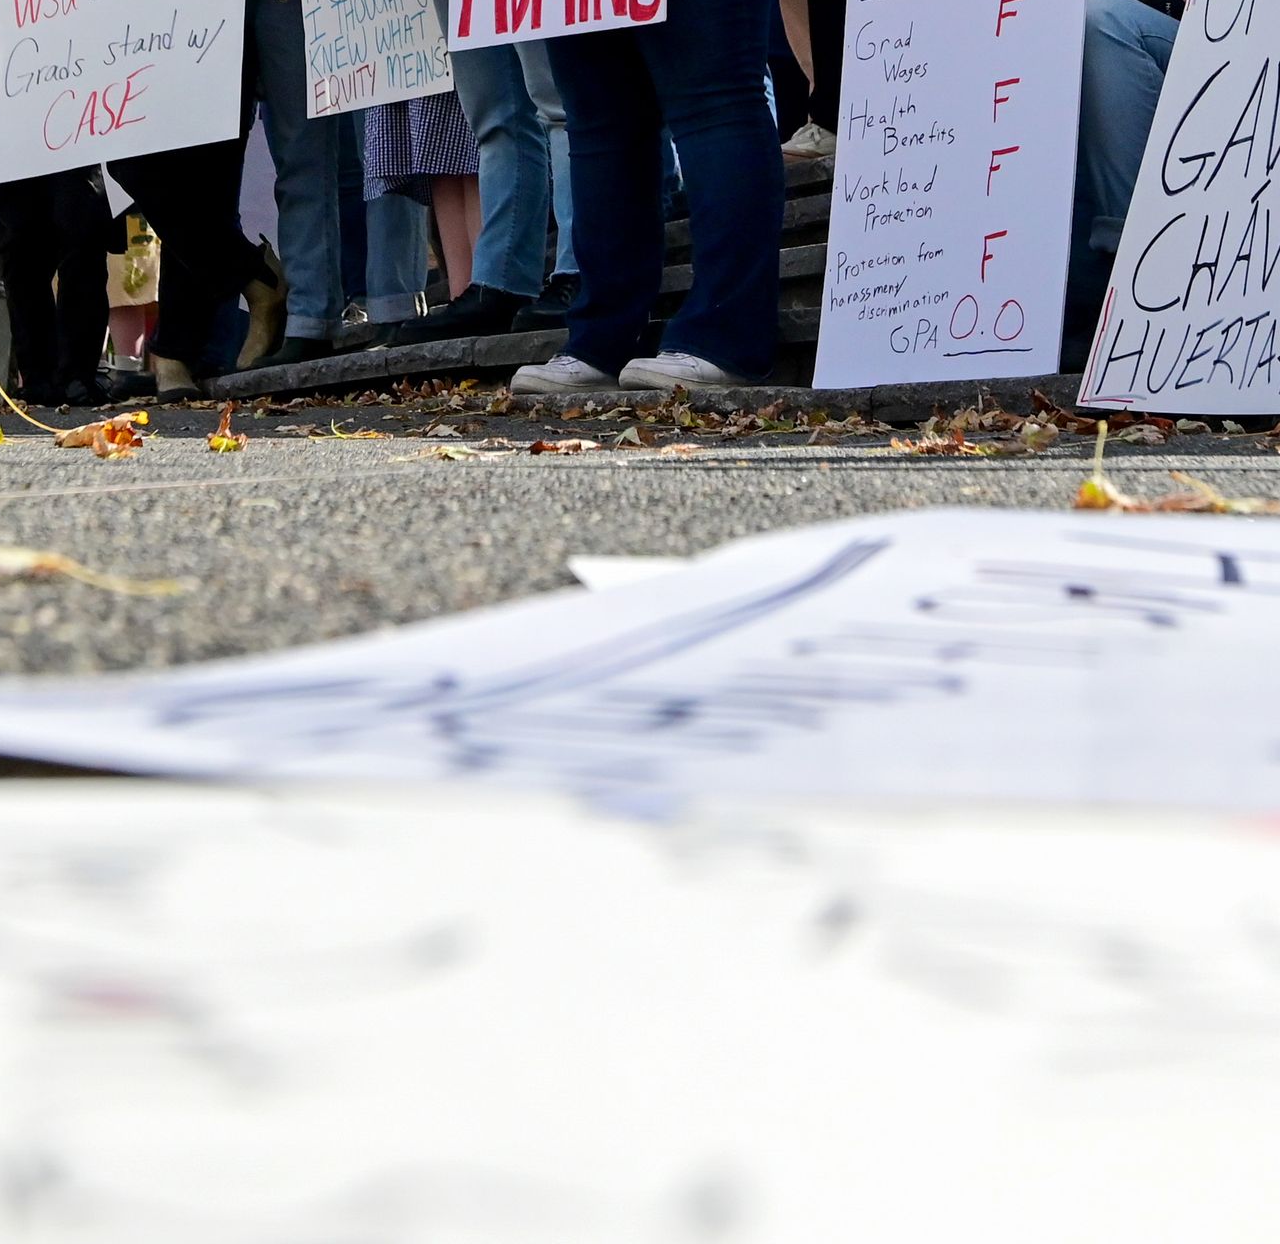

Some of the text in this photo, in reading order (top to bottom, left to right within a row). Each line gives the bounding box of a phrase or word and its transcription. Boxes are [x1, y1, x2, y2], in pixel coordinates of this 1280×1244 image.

[305, 6, 327, 46] I
[309, 10, 427, 80] KNEW WHAT
[855, 20, 914, 61] Grad
[5, 9, 226, 98] Grads stand w/
[314, 36, 450, 116] EQUITY MEANS?
[883, 53, 928, 84] Wages
[43, 63, 156, 151] CASE
[849, 93, 917, 141] Health
[993, 78, 1021, 123] F
[883, 120, 956, 156] Benefits
[987, 145, 1020, 197] F
[864, 200, 933, 233] Protection
[836, 242, 944, 285] Protection from
[981, 230, 1008, 284] F
[858, 290, 949, 321] discrimination
[889, 294, 1025, 354] GPA 0.0
